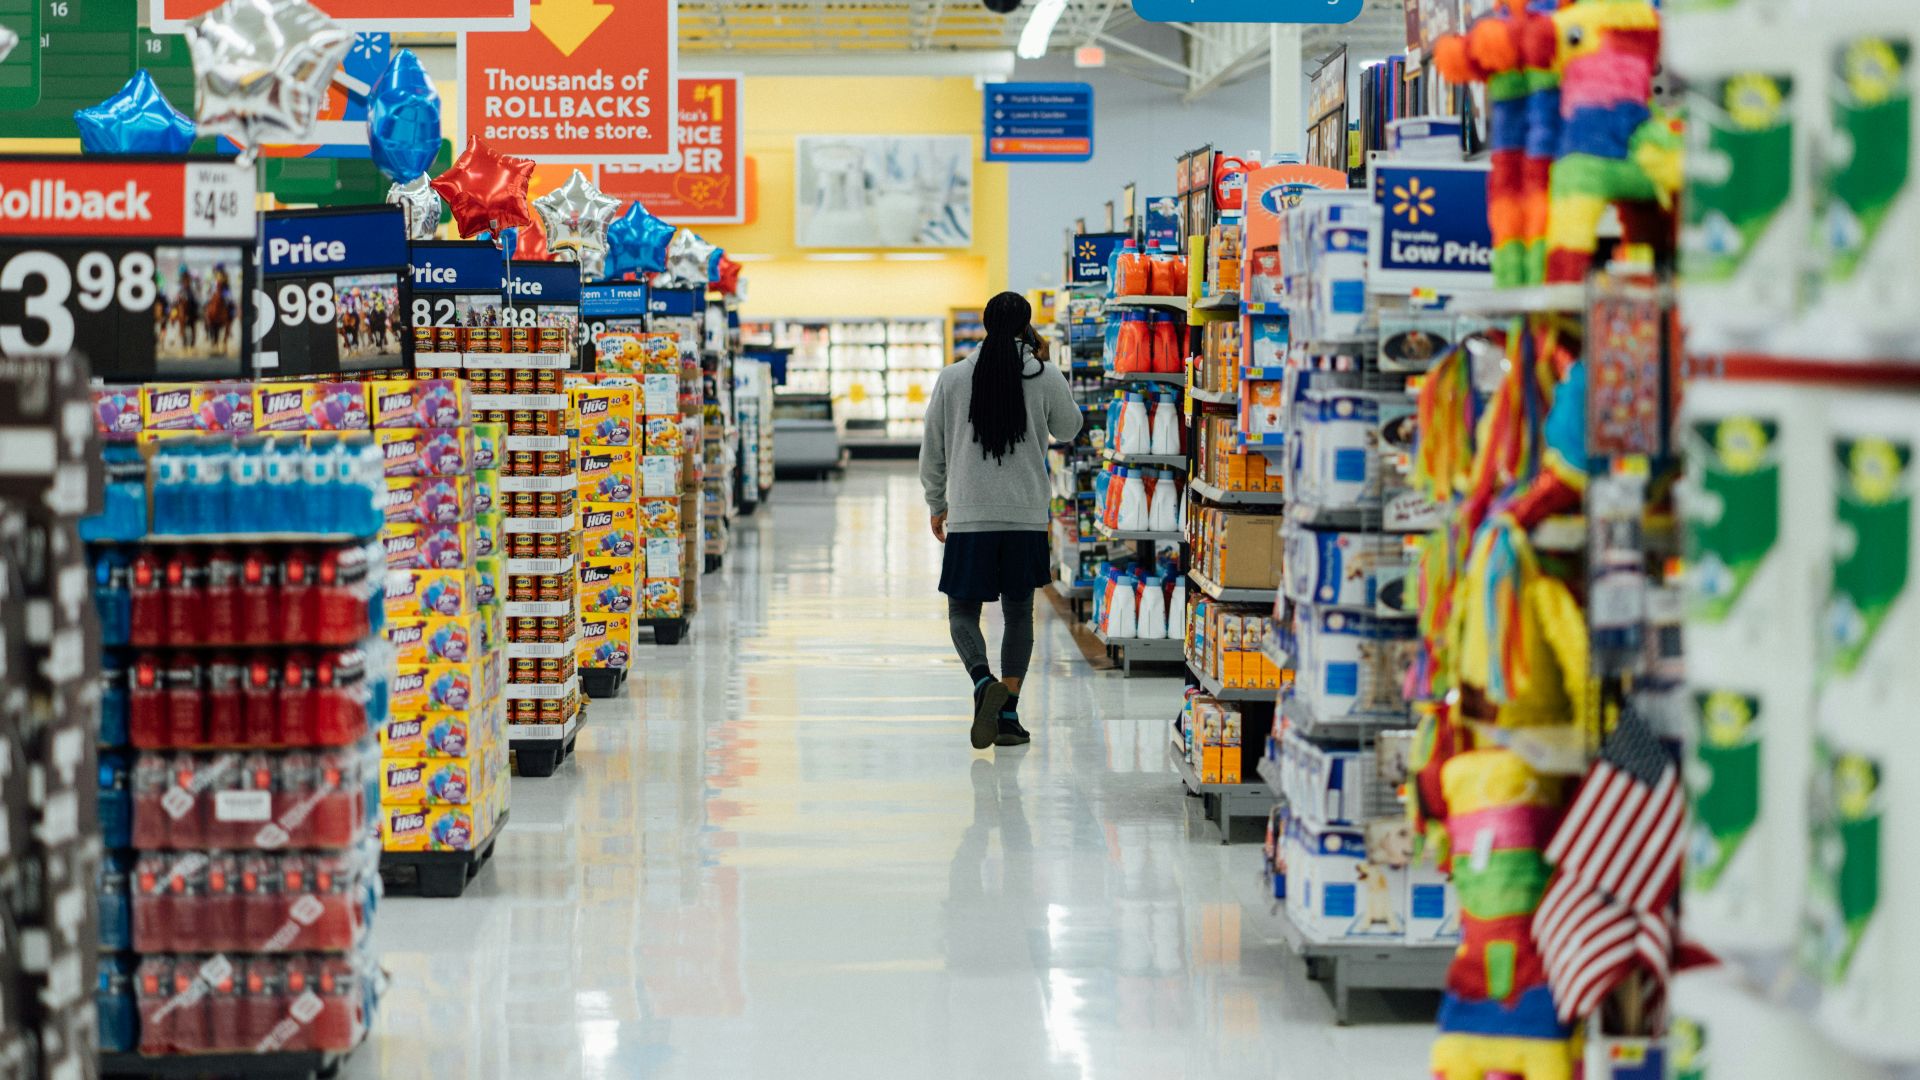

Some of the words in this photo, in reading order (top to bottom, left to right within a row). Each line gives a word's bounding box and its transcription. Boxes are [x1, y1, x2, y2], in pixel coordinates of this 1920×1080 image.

[50, 2, 69, 17] 16
[145, 39, 162, 53] 18
[484, 68, 614, 91] Thousands
[620, 68, 649, 91] of
[485, 96, 651, 118] ROLLBACKS
[694, 83, 723, 121] #1
[485, 124, 549, 140] across
[554, 122, 590, 140] the
[595, 122, 652, 140] store.
[678, 125, 723, 145] RICE
[269, 235, 346, 265] Price
[1391, 239, 1441, 263] Low
[1443, 240, 1494, 265] Pric
[617, 288, 641, 298] meal
[155, 393, 190, 413] HUG
[267, 393, 302, 414] HUG
[383, 394, 412, 411] HUG
[582, 400, 608, 414] HUG
[386, 442, 416, 458] HUG
[586, 513, 611, 528] HUG
[614, 510, 625, 518] 40
[387, 538, 416, 554] HUG
[393, 627, 421, 642] HUG
[394, 674, 423, 691] HUG
[391, 721, 420, 738] HUG
[391, 768, 420, 786] HUG
[394, 815, 423, 832] HUG
